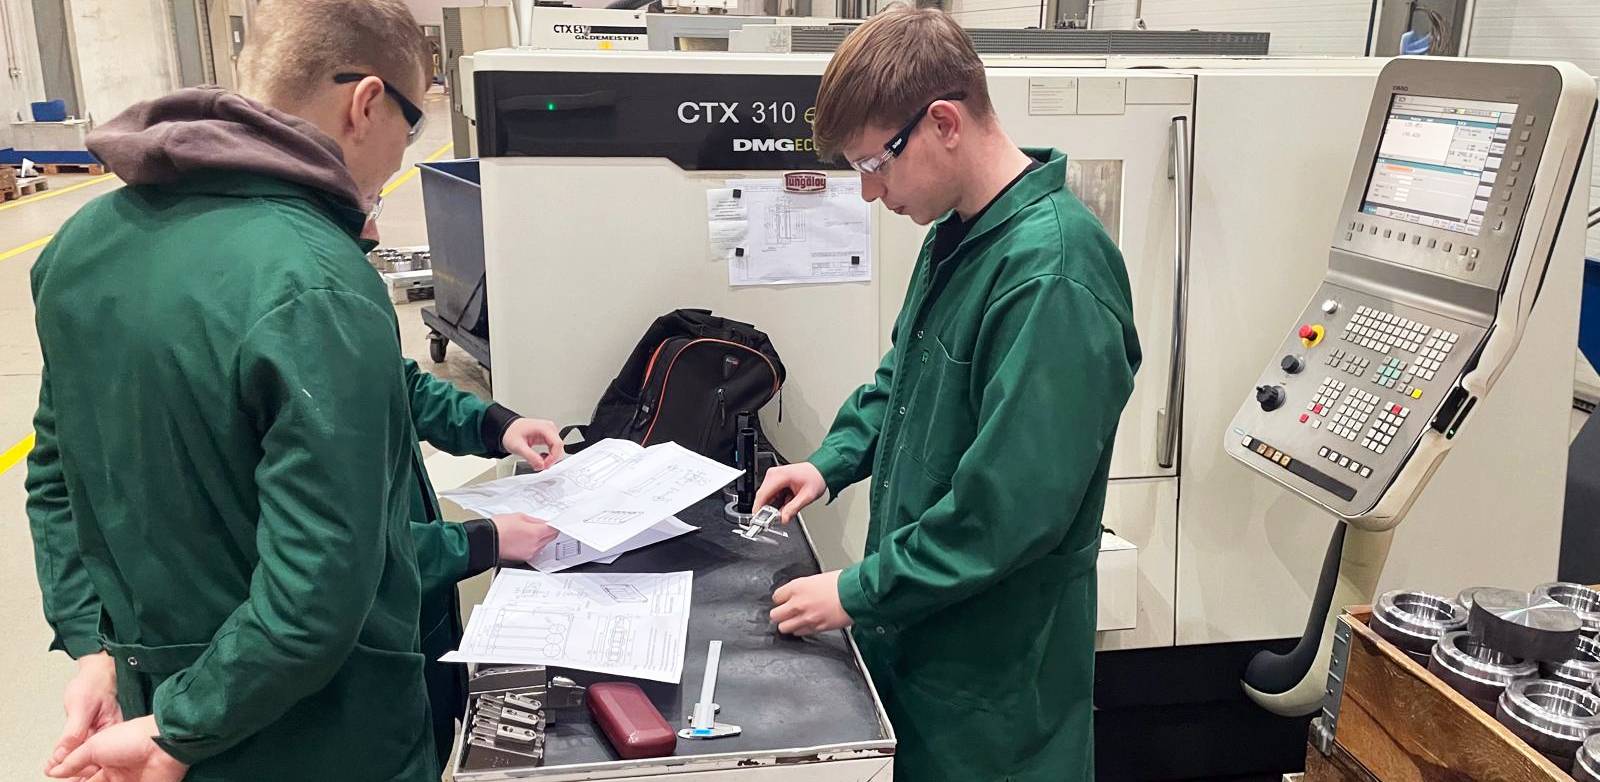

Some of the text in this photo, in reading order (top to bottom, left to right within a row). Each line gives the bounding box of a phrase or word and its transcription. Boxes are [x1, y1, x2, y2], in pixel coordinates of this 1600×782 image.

[554, 25, 572, 33] CTX
[677, 101, 739, 124] CTX
[751, 101, 796, 124] 310
